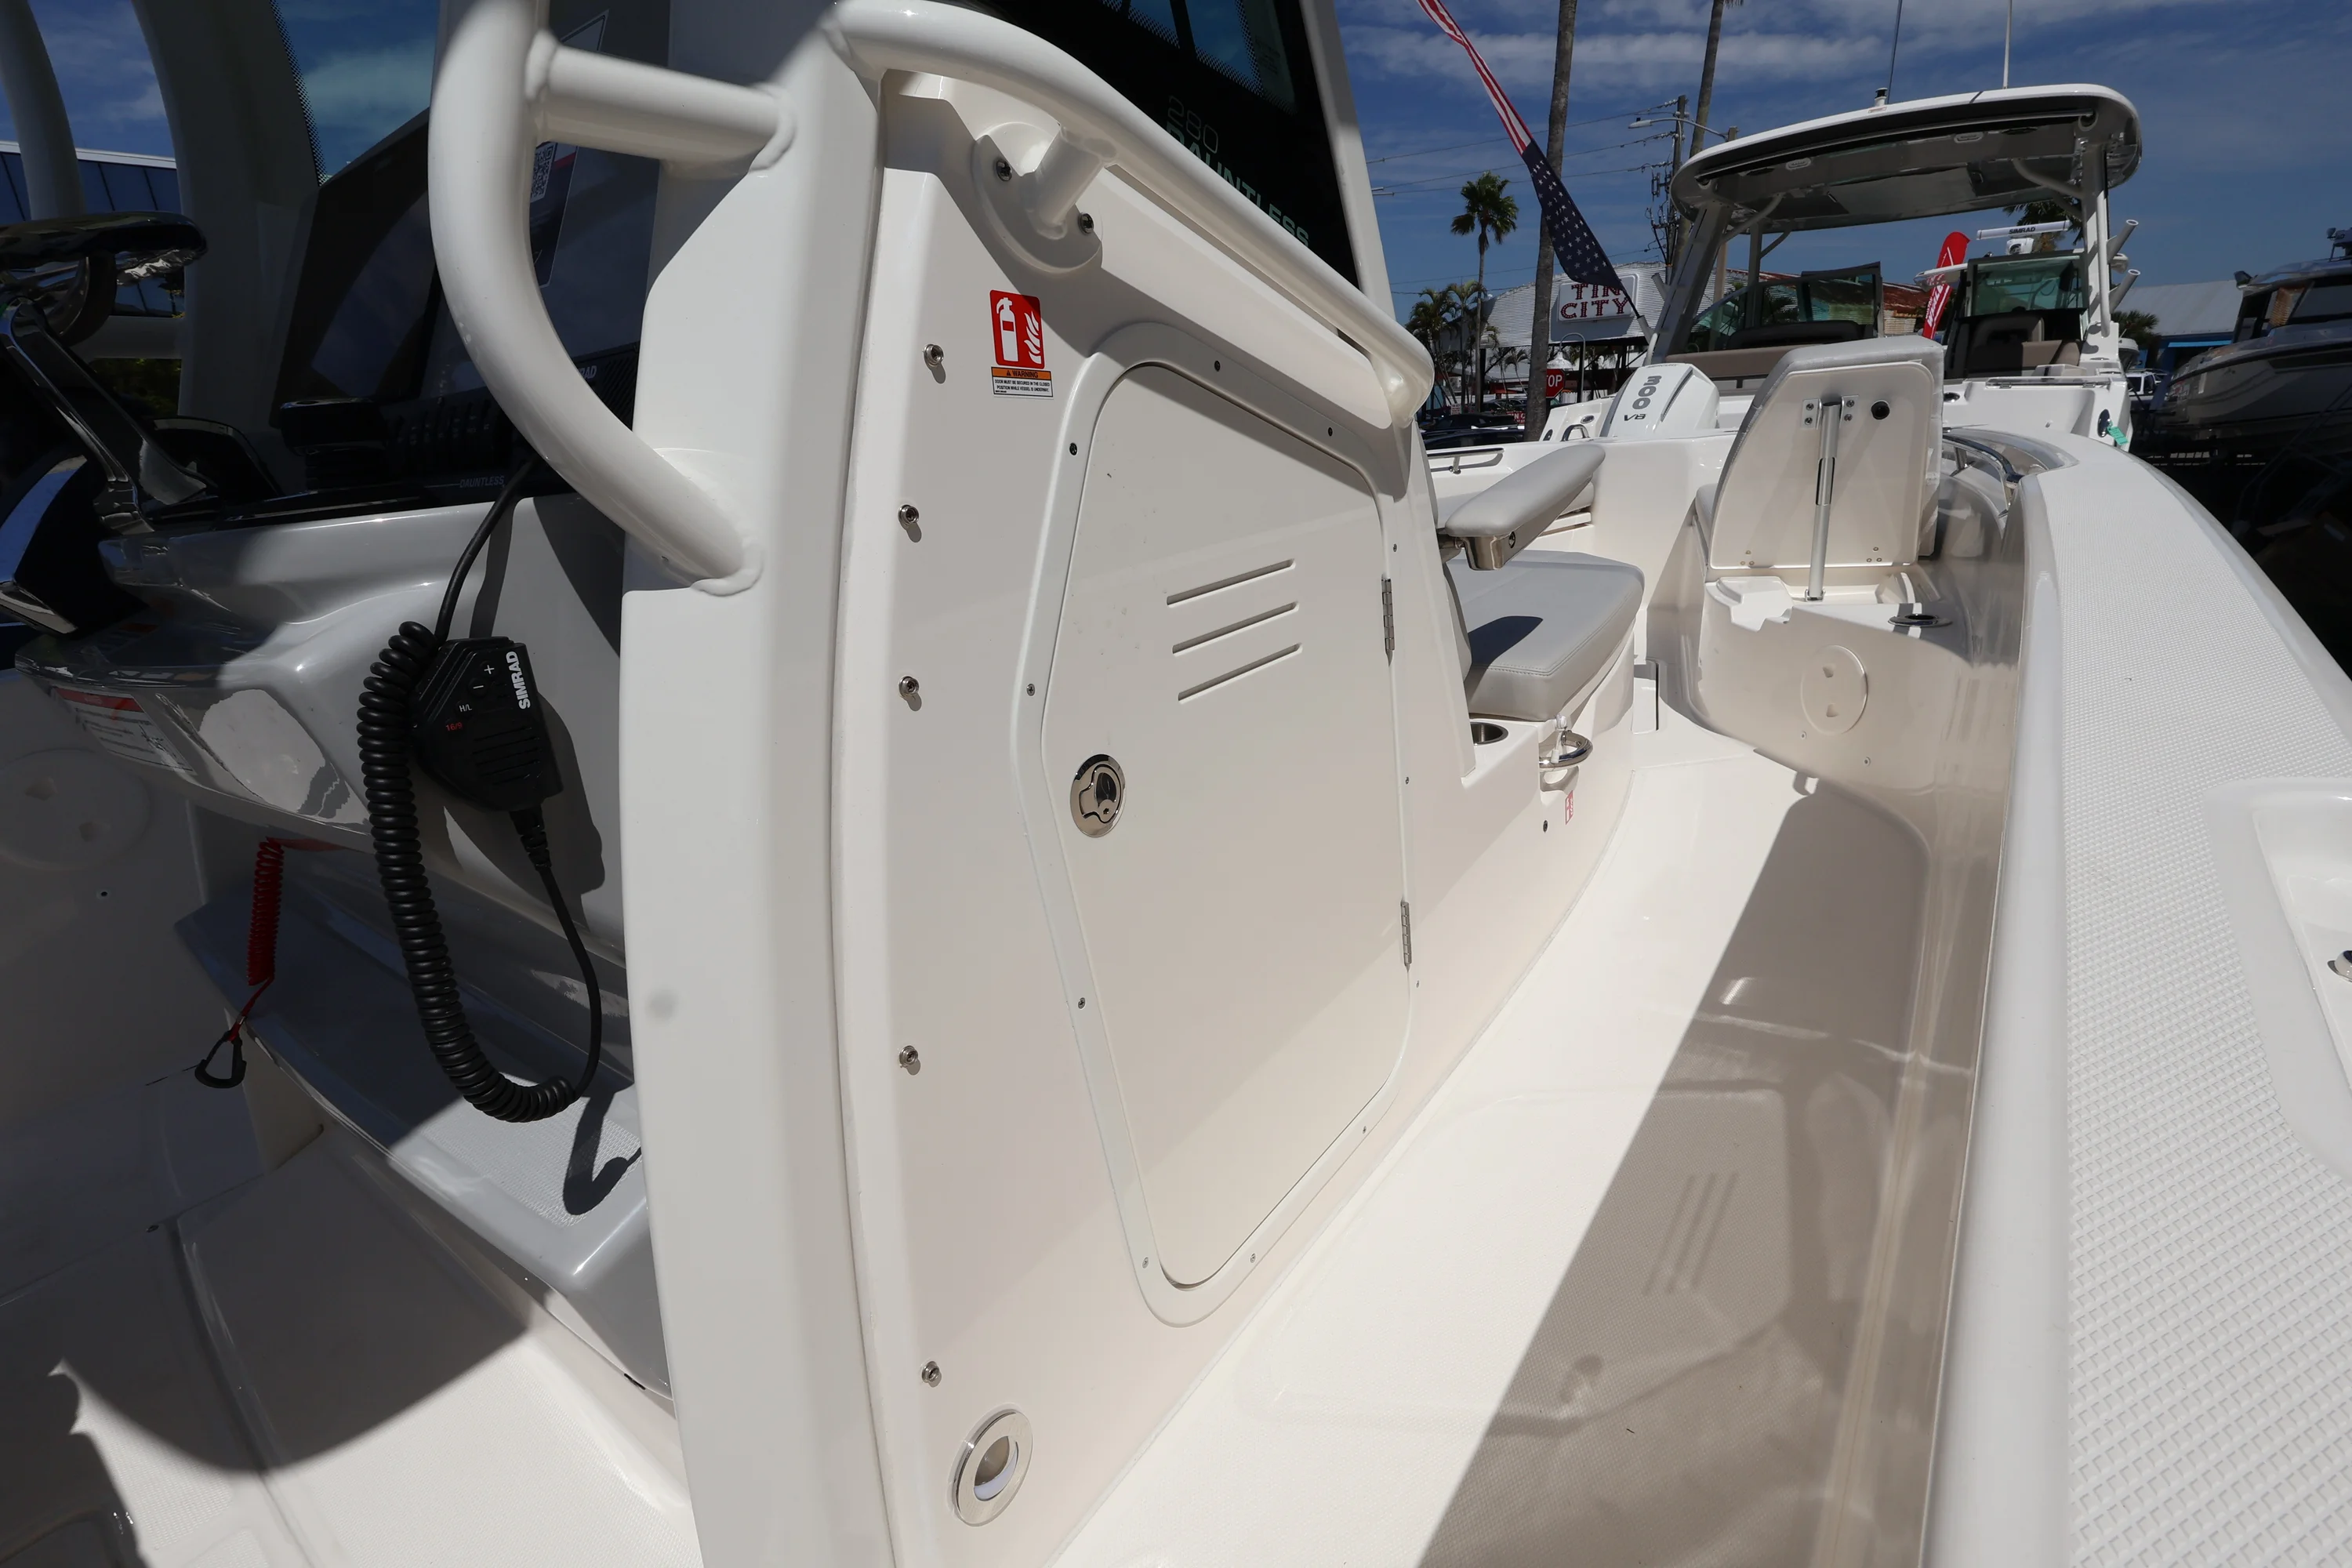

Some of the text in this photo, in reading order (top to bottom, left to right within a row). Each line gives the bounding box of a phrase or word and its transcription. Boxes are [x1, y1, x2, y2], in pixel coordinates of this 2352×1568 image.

[1168, 95, 1218, 154] 280
[1560, 298, 1630, 319] CITY
[1632, 376, 1662, 410] 300
[459, 474, 505, 488] DAUNTLESS
[506, 651, 531, 710] SIMRAD
[459, 704, 472, 713] H/L
[445, 722, 463, 731] 16/9
